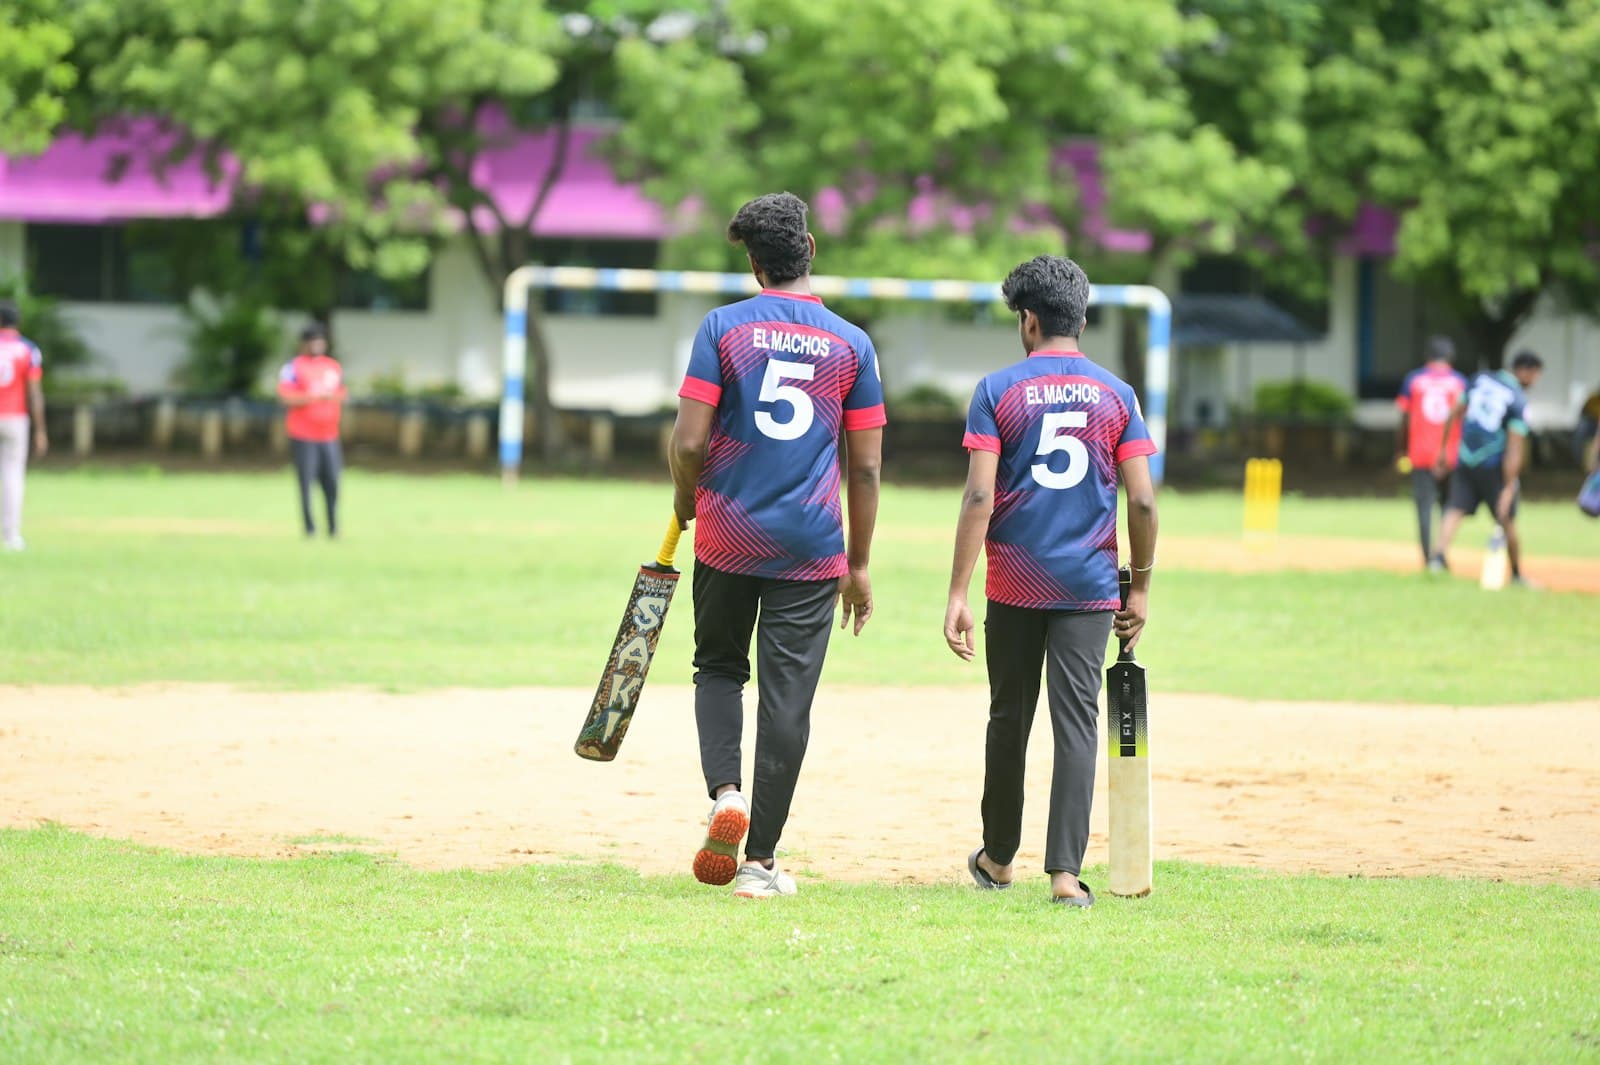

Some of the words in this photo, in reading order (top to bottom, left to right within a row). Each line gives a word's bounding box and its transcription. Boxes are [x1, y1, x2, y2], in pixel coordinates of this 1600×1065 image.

[753, 327, 770, 349] EL
[771, 330, 831, 357] MACHOS
[754, 358, 816, 441] 5
[1026, 385, 1044, 405] EL
[1043, 383, 1100, 404] MACHOS
[1031, 411, 1089, 489] 5
